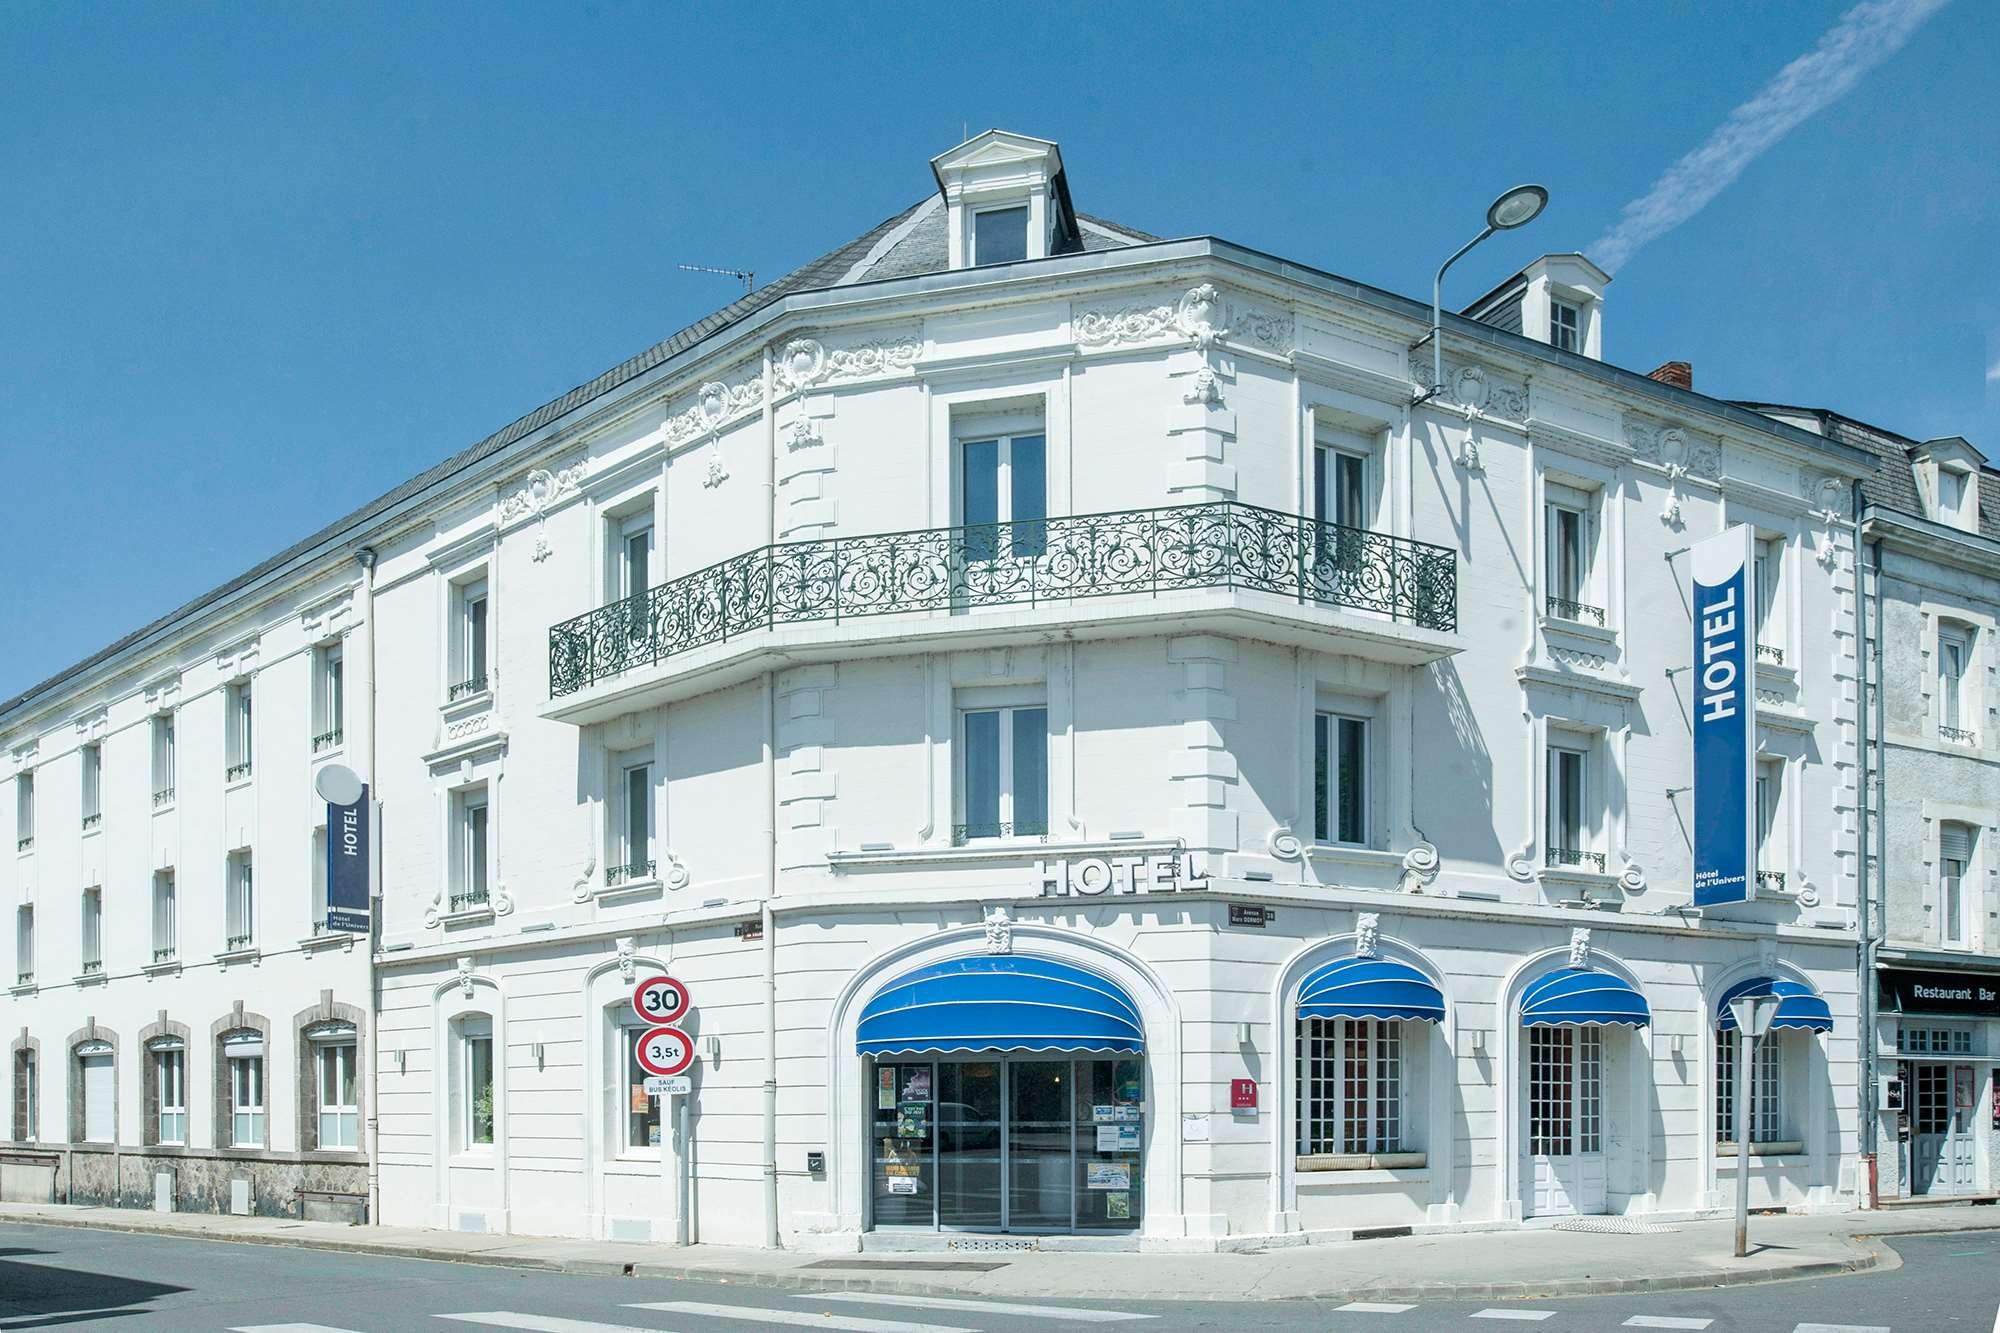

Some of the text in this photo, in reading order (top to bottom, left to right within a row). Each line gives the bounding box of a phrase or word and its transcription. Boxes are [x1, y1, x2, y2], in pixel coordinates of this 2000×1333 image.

[1703, 586, 1736, 723] HOTEL
[343, 807, 358, 856] HOTEL
[1033, 852, 1209, 897] HOTEL
[1695, 869, 1719, 880] Hôtel
[1695, 880, 1706, 888] de
[645, 989, 680, 1012] 30
[1913, 984, 1997, 1001] Restaurant Bar
[1242, 1083, 1253, 1095] H
